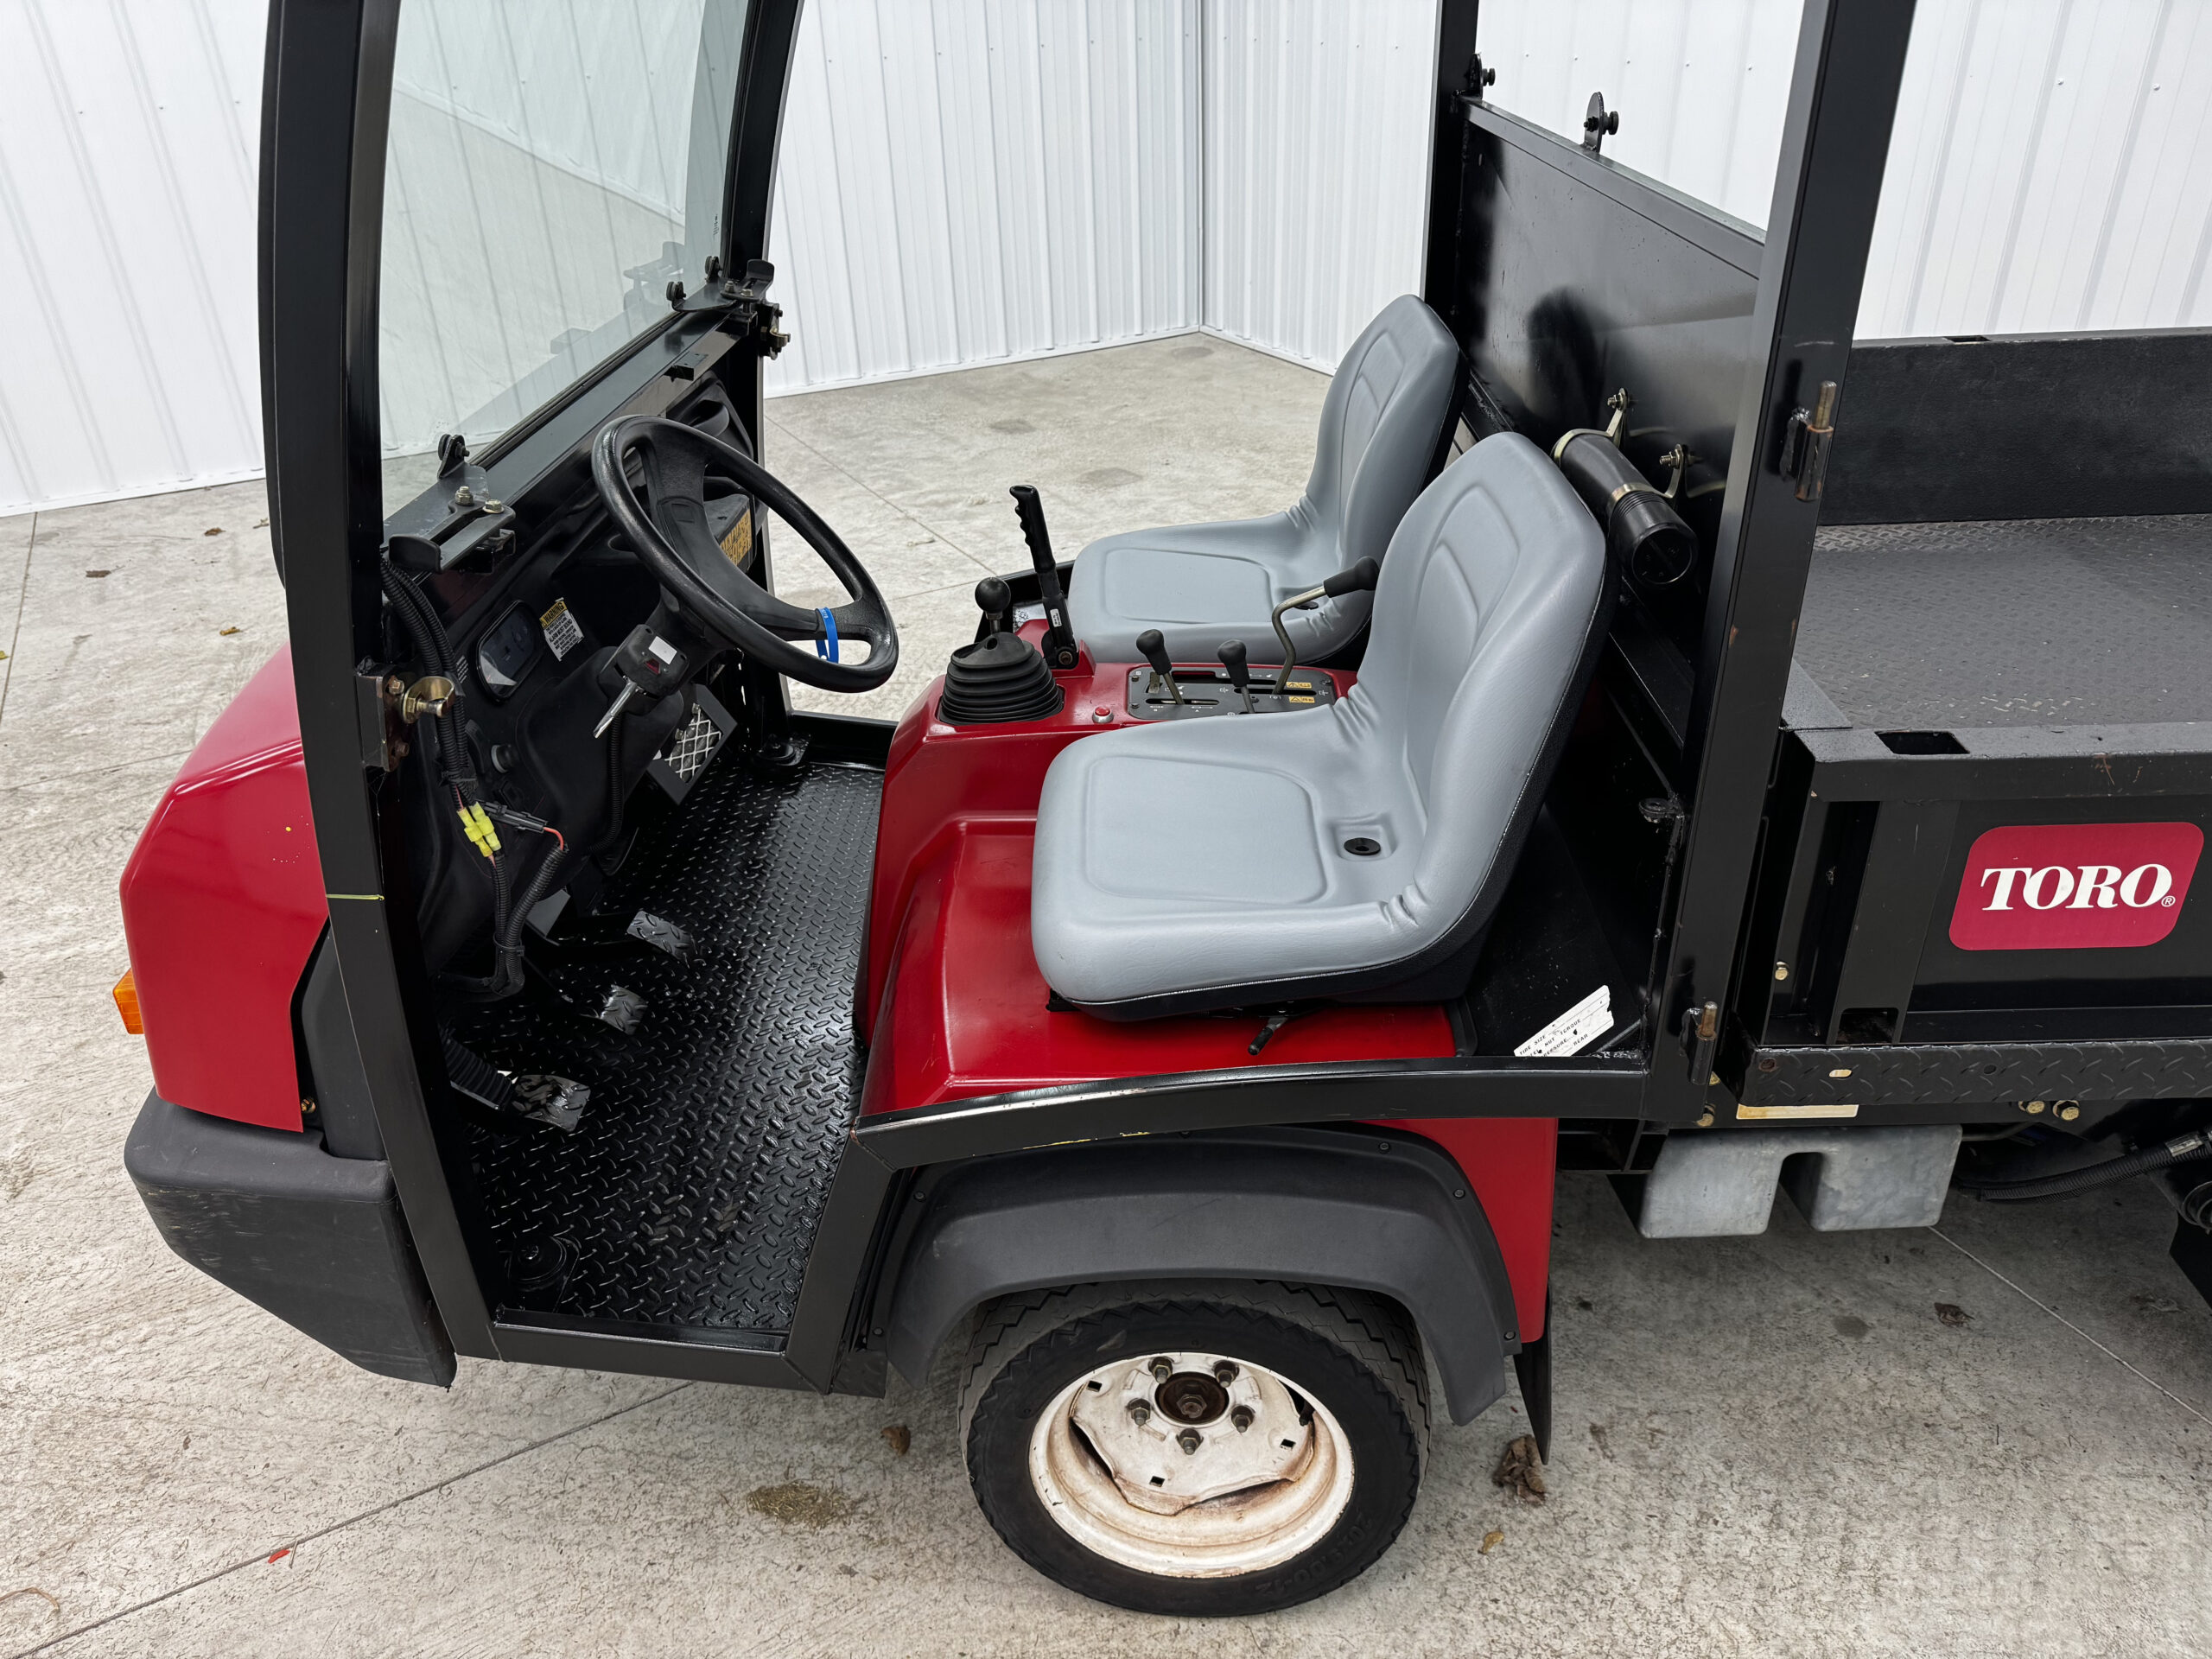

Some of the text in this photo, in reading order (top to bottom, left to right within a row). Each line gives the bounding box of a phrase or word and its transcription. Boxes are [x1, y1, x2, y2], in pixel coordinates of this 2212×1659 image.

[543, 602, 564, 622] WARNING
[1980, 863, 2172, 911] TORO
[1535, 1035, 1546, 1045] SIZE
[1544, 1037, 1554, 1046] NUT
[1560, 1019, 1580, 1035] TORQUE
